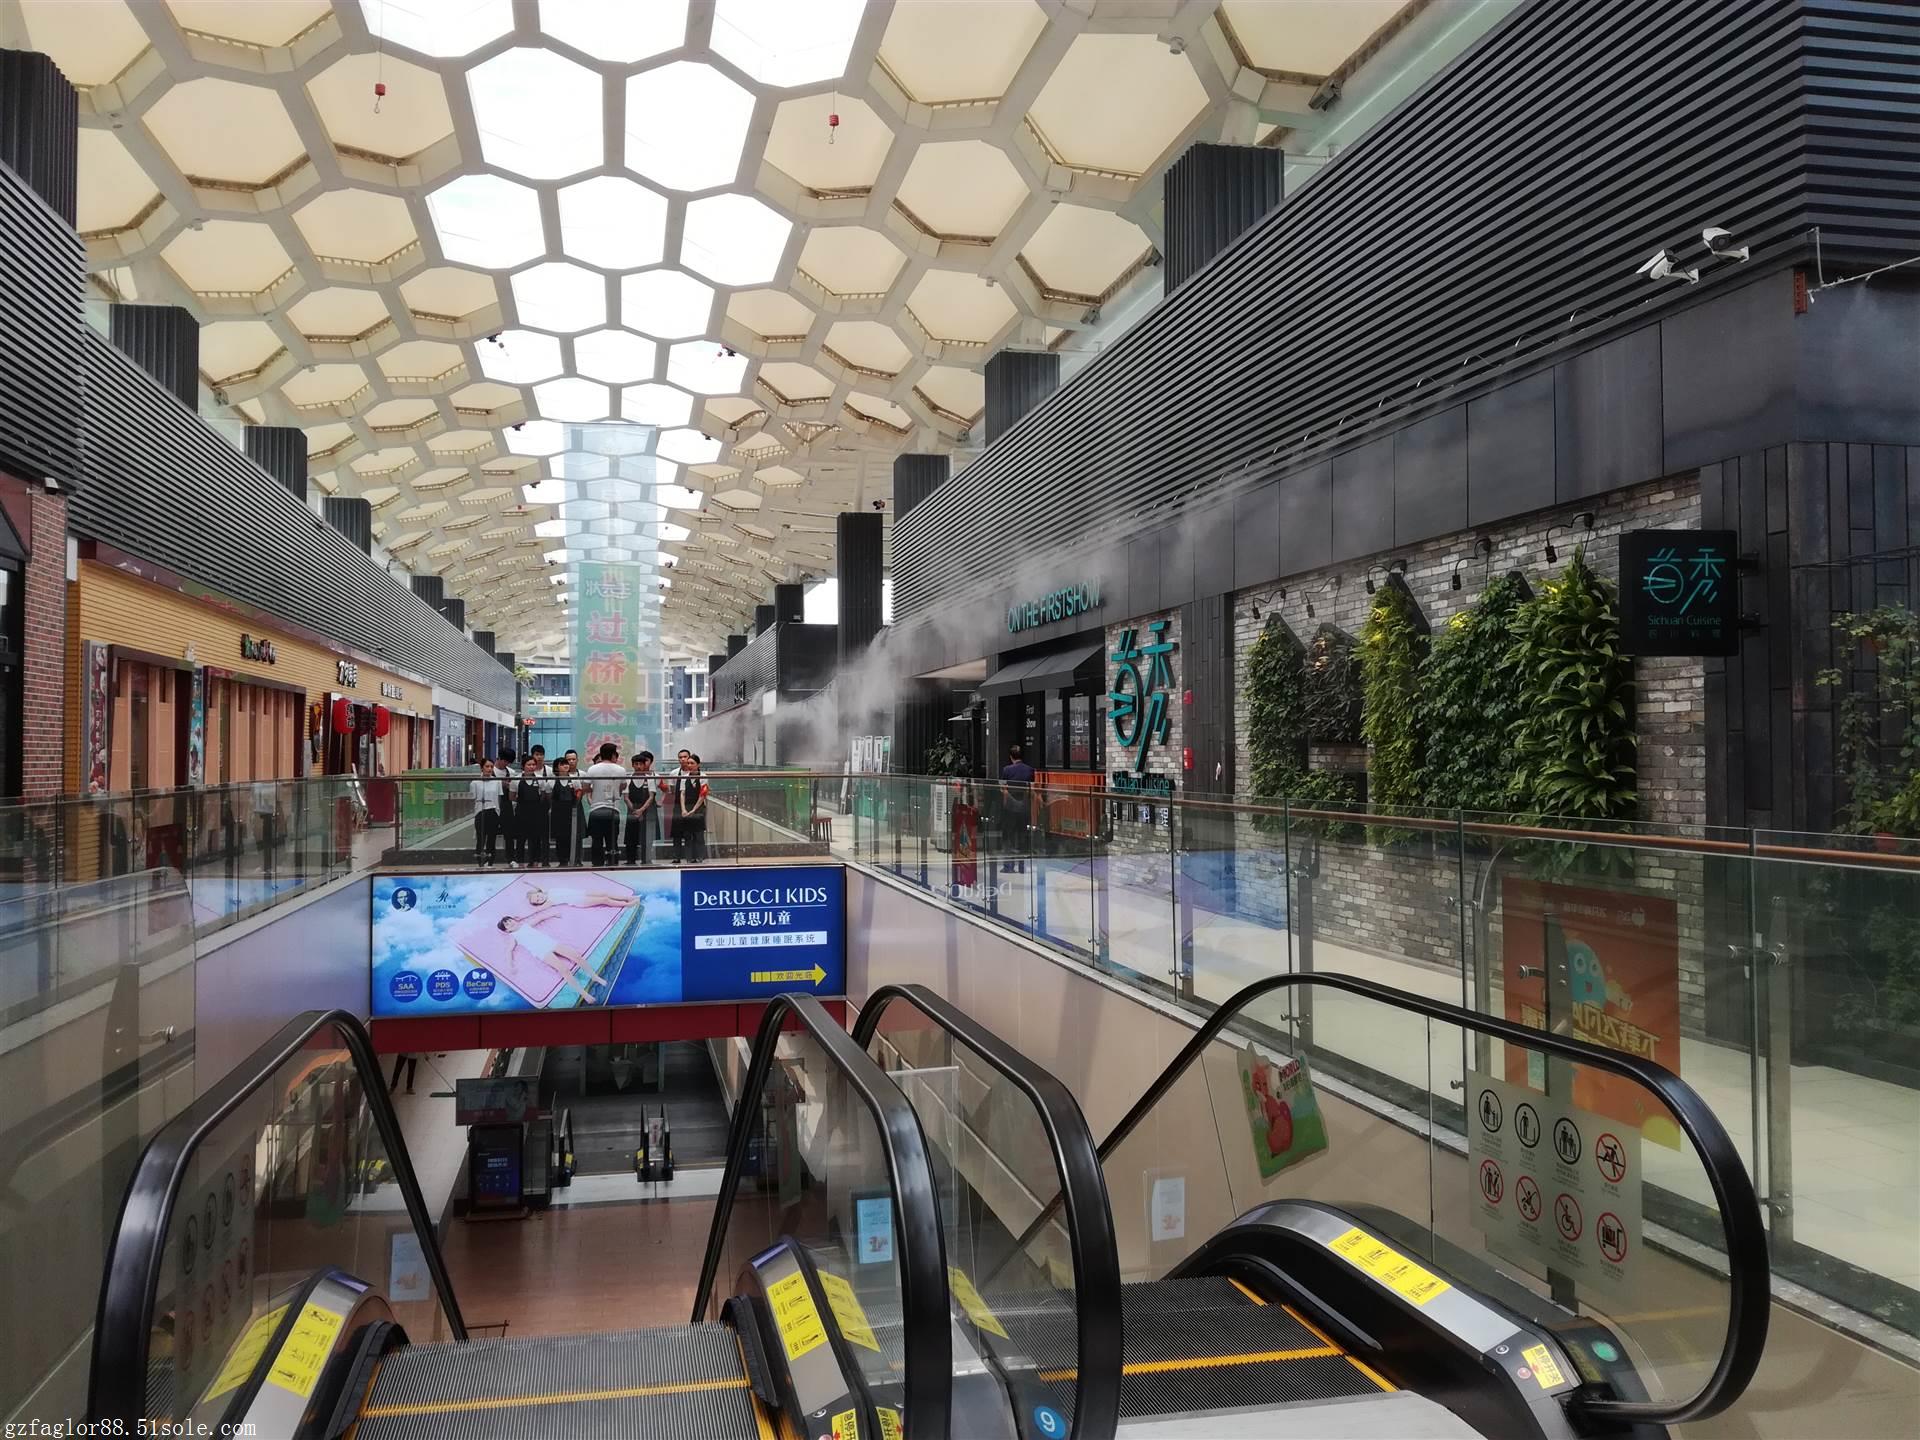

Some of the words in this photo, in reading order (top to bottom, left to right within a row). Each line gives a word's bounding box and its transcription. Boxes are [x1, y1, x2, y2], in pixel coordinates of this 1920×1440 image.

[1007, 606, 1020, 633] ON
[1022, 601, 1039, 629] THE
[1647, 615, 1684, 625] Sichuan
[1686, 615, 1722, 625] Cuisine
[694, 889, 780, 906] DeRUCCI
[786, 887, 827, 903] KIDS
[732, 911, 792, 927] 慕思儿童
[704, 934, 816, 947] 专业儿童健康睡眠系统
[435, 981, 451, 989] PDS
